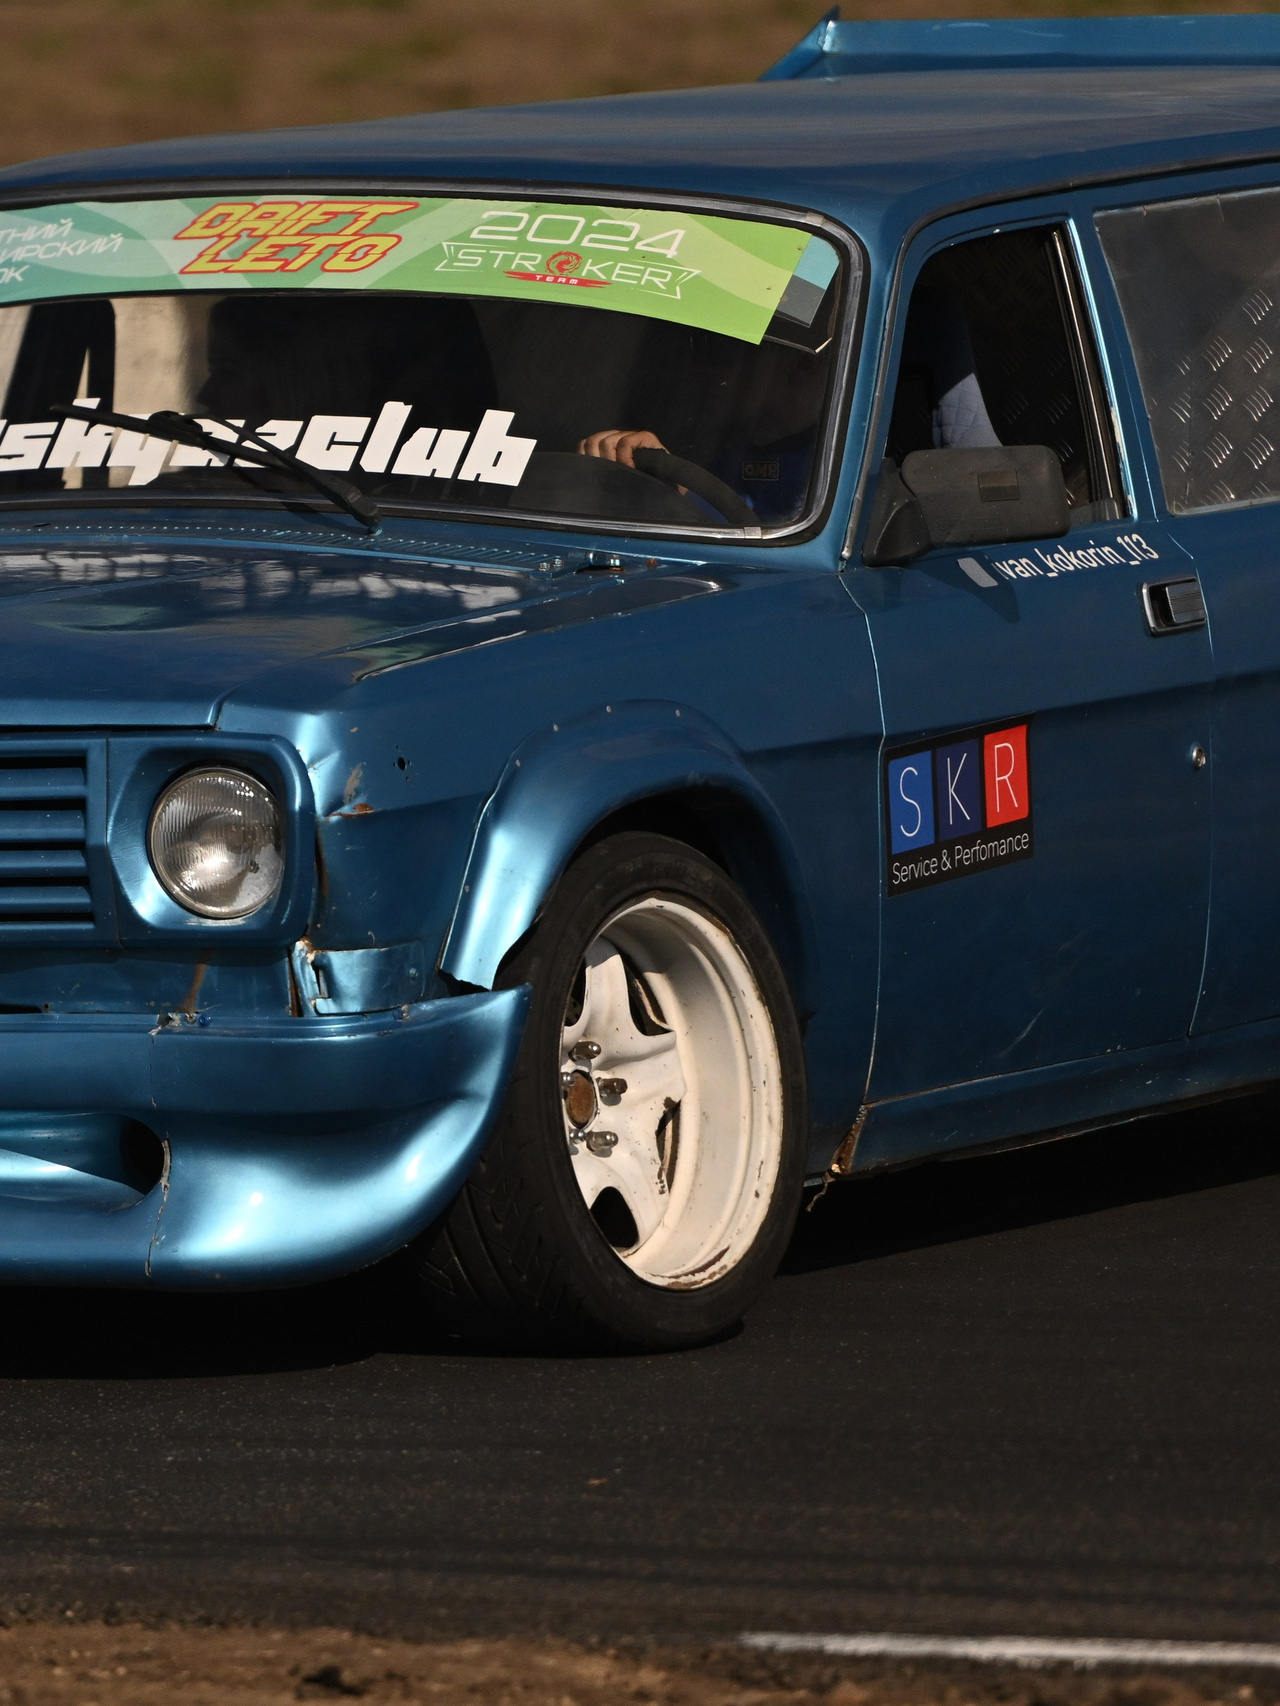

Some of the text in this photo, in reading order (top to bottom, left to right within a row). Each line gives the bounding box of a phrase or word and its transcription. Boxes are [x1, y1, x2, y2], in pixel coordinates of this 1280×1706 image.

[173, 200, 420, 239] DRIFT
[470, 210, 686, 259] 2024
[179, 234, 402, 274] LETO
[535, 274, 579, 285] TEAM
[899, 742, 1019, 838] SKR
[892, 832, 1030, 885] Service & Perfomance
